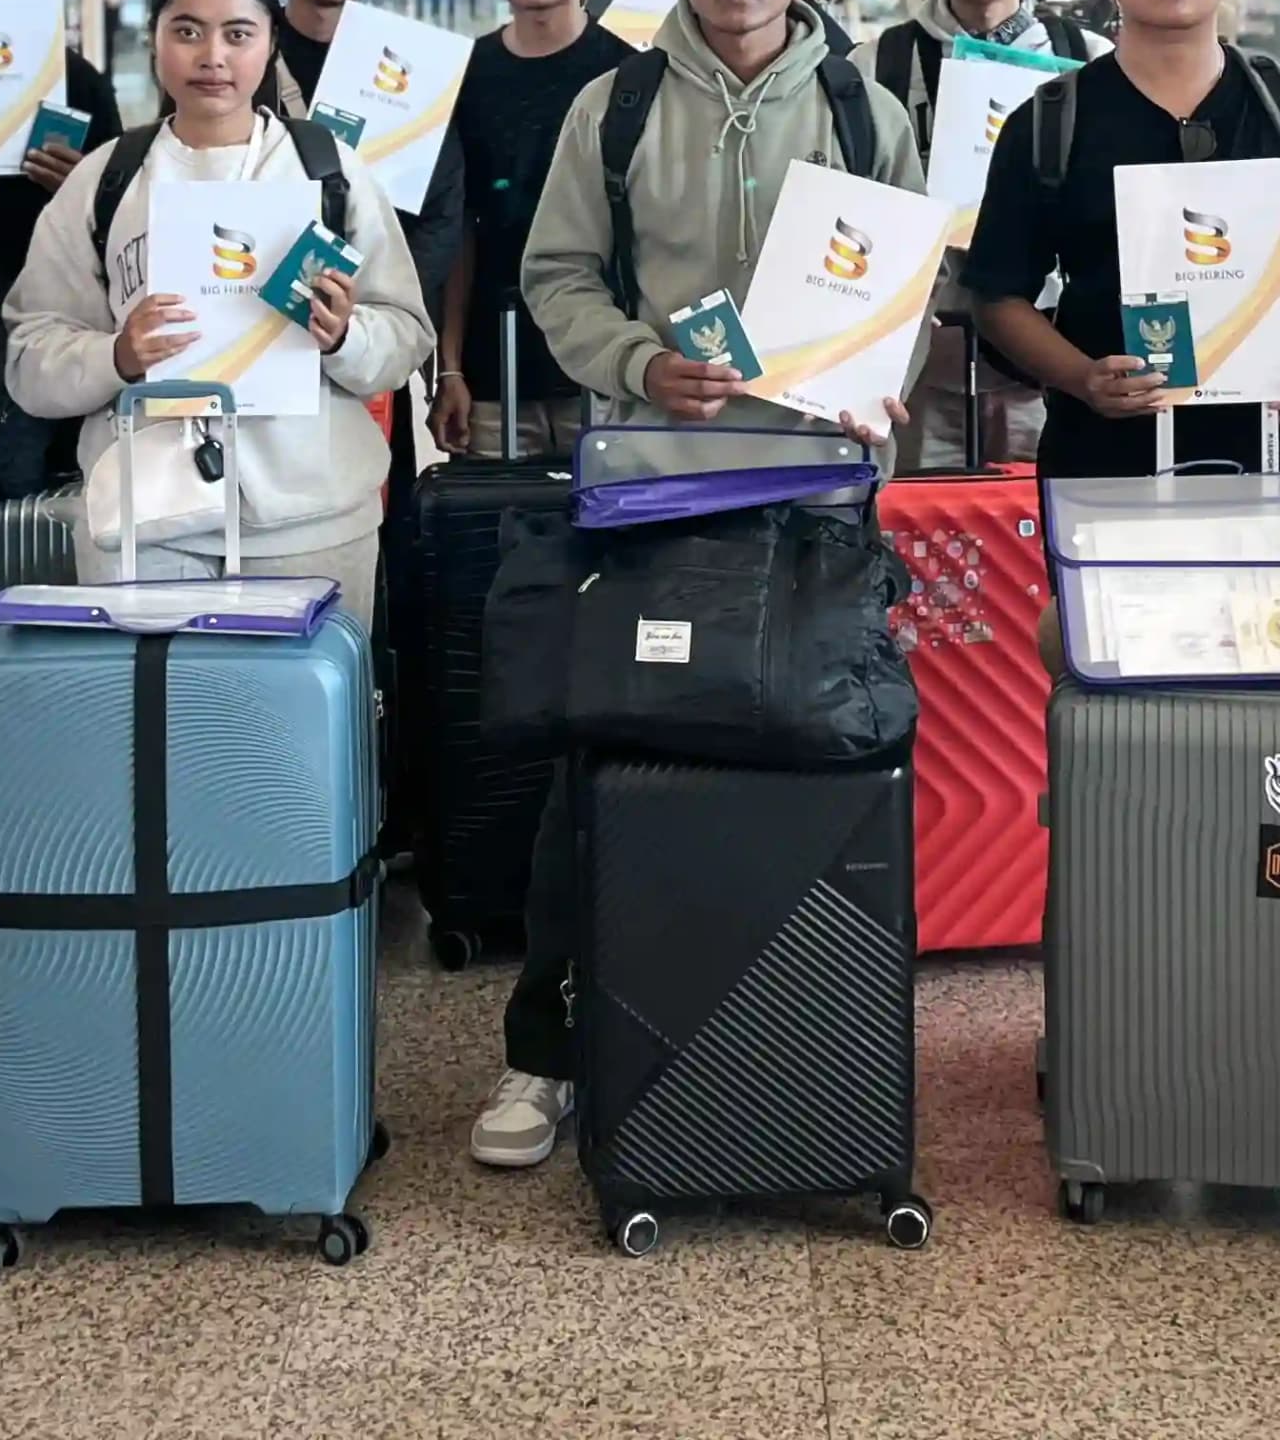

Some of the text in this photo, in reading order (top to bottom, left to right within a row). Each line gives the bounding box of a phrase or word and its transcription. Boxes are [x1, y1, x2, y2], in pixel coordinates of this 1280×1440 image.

[1175, 269, 1246, 282] BIG HIRING
[200, 285, 263, 297] BIG HIRIN
[805, 273, 872, 302] BIG HIRING
